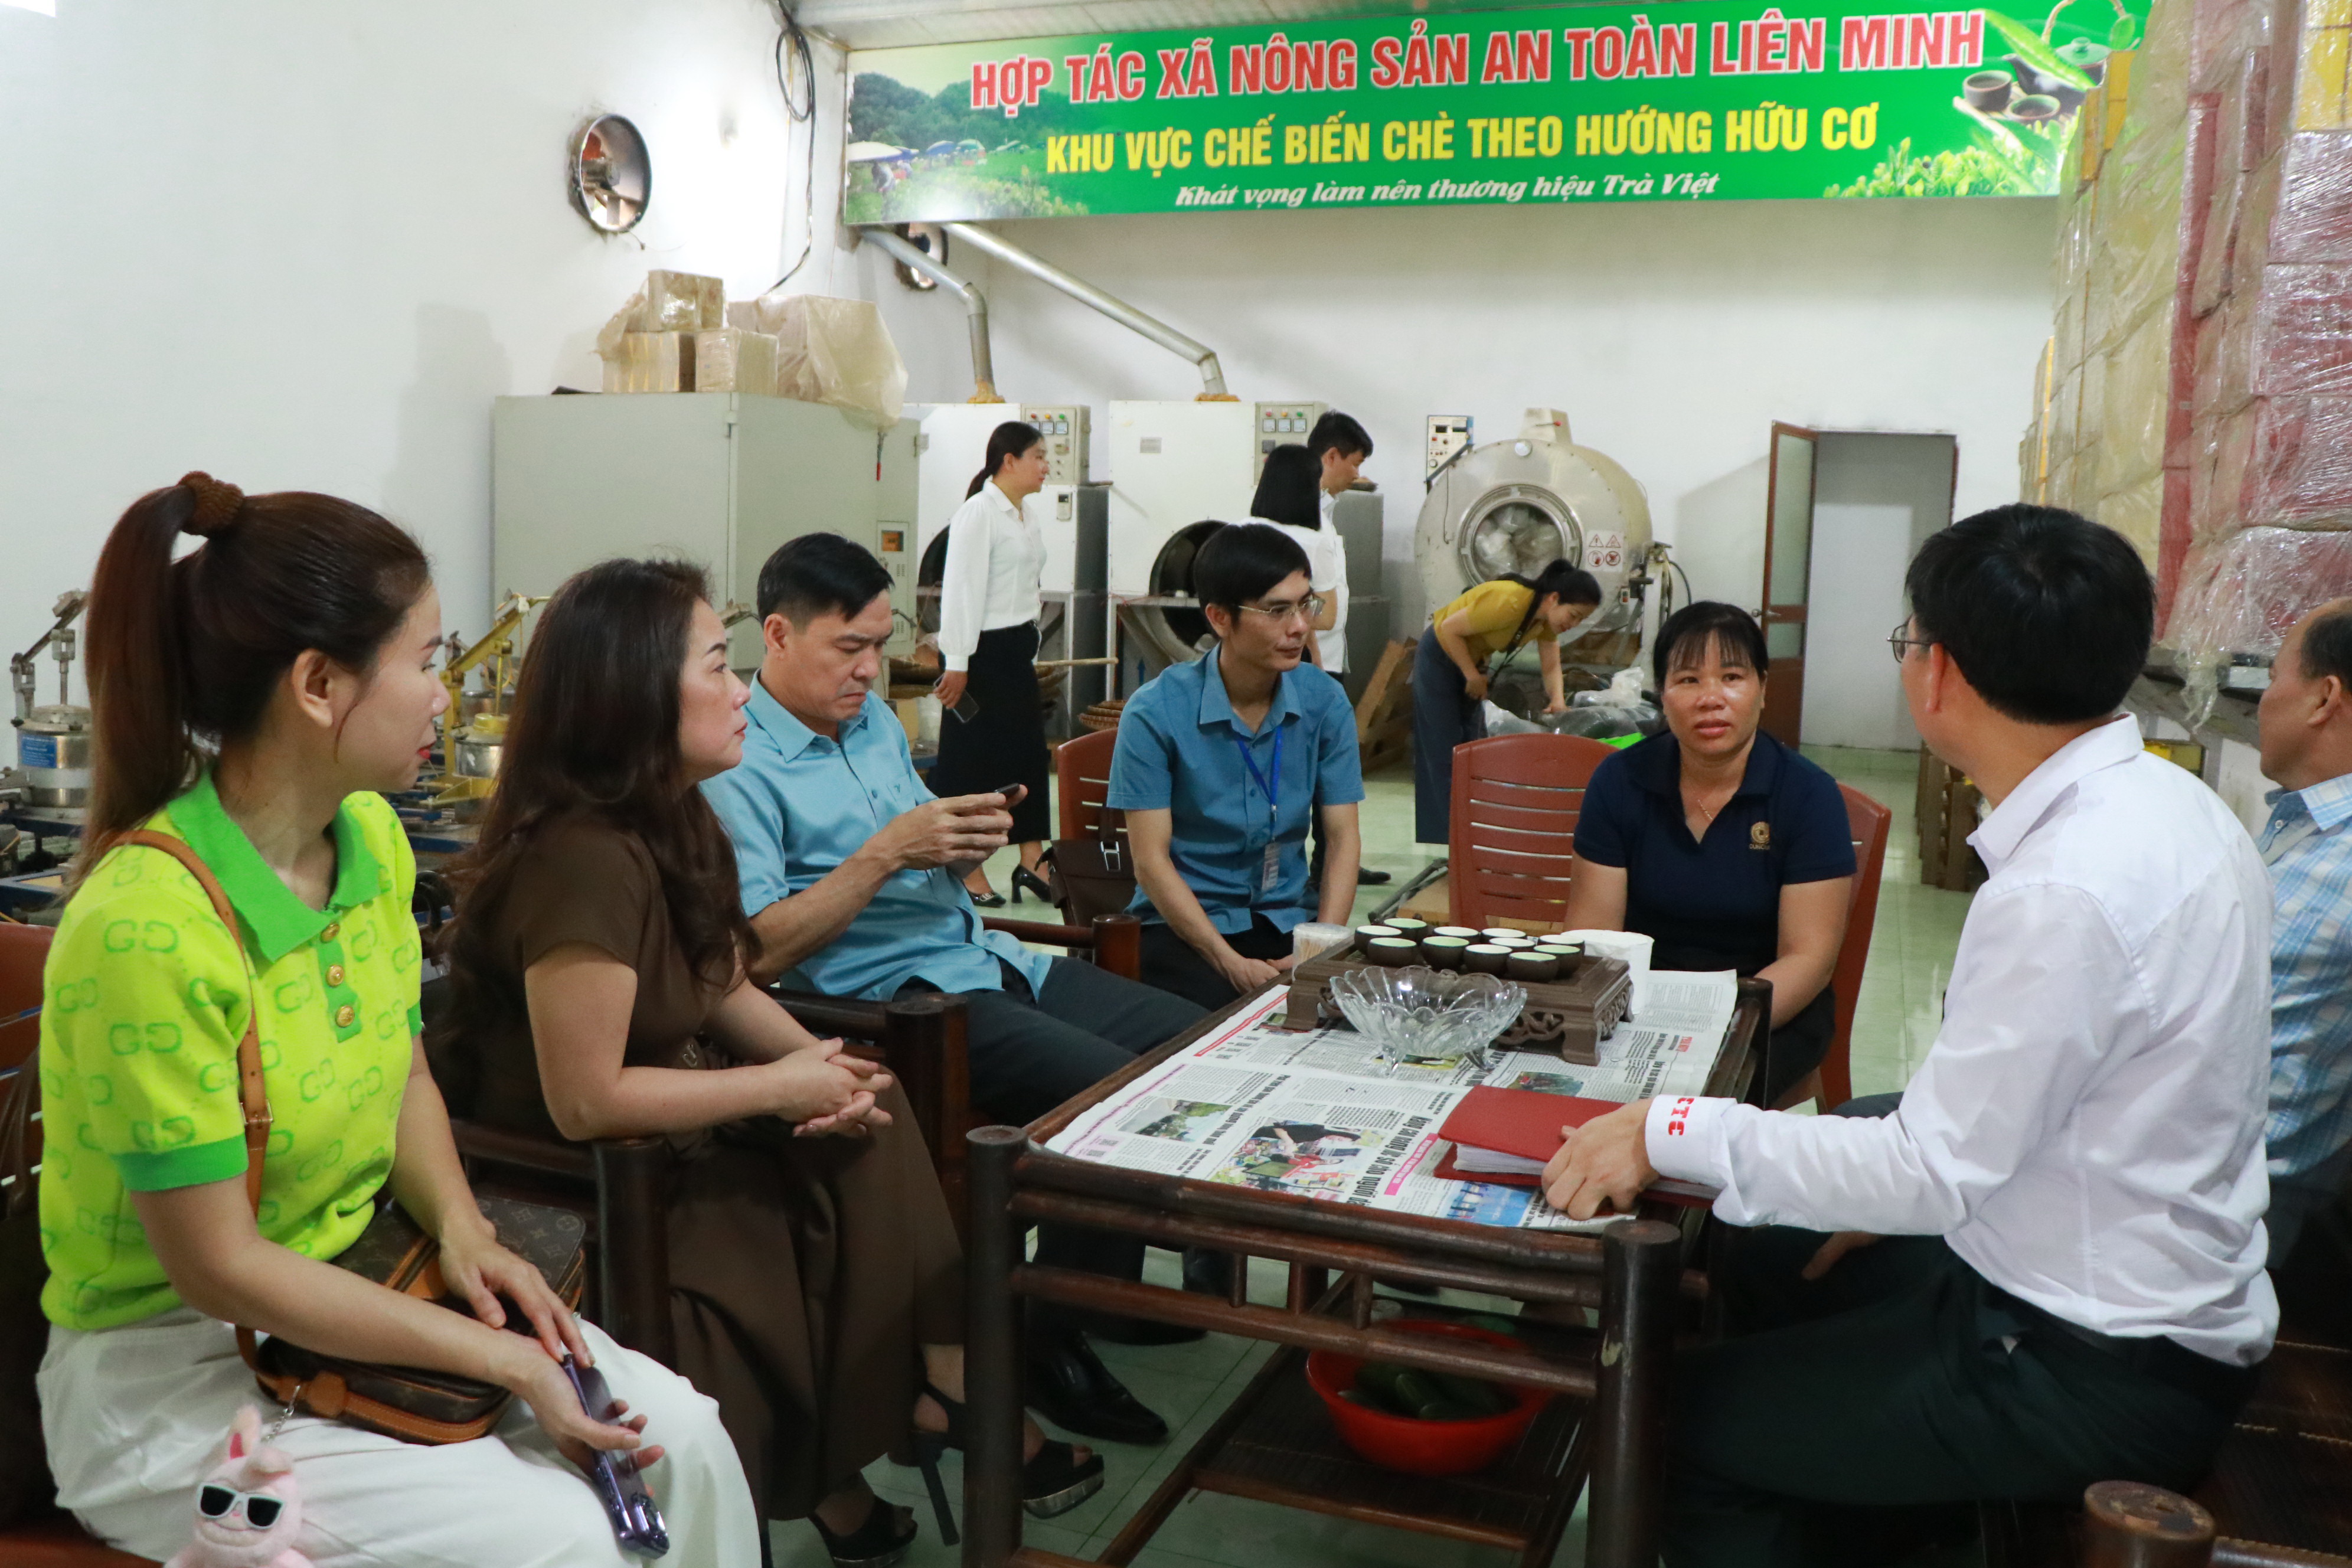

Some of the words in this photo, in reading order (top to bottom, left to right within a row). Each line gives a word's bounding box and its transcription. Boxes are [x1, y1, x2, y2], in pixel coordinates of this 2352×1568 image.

[972, 55, 1053, 116] HỢP
[1065, 44, 1145, 102] TÁC
[1158, 39, 1217, 97] XÃ
[1230, 34, 1357, 94] NÔNG
[1371, 19, 1469, 87] SẢN
[1482, 31, 1551, 83] AN
[1566, 16, 1696, 79] TOÀN
[1712, 9, 1825, 74] LIÊN
[1841, 13, 1982, 70] MINH
[1046, 133, 1115, 173] KHU
[1125, 126, 1193, 178] VỰC
[1204, 113, 1276, 168] CHẾ
[1284, 110, 1370, 164] BIẾN
[1383, 110, 1455, 161] CHÈ
[1467, 115, 1563, 158] THEO
[1576, 104, 1713, 156] HƯỚNG
[1726, 100, 1808, 152] HỮU
[1821, 102, 1880, 151] CƠ
[1175, 183, 1239, 207] Khát
[1243, 185, 1306, 209] vọng
[1311, 179, 1366, 203] làm
[1370, 178, 1423, 201] nên
[1427, 177, 1528, 202] thương
[1532, 174, 1596, 200] hiệu
[1603, 172, 1655, 196] Trà
[1661, 171, 1721, 200] Việt
